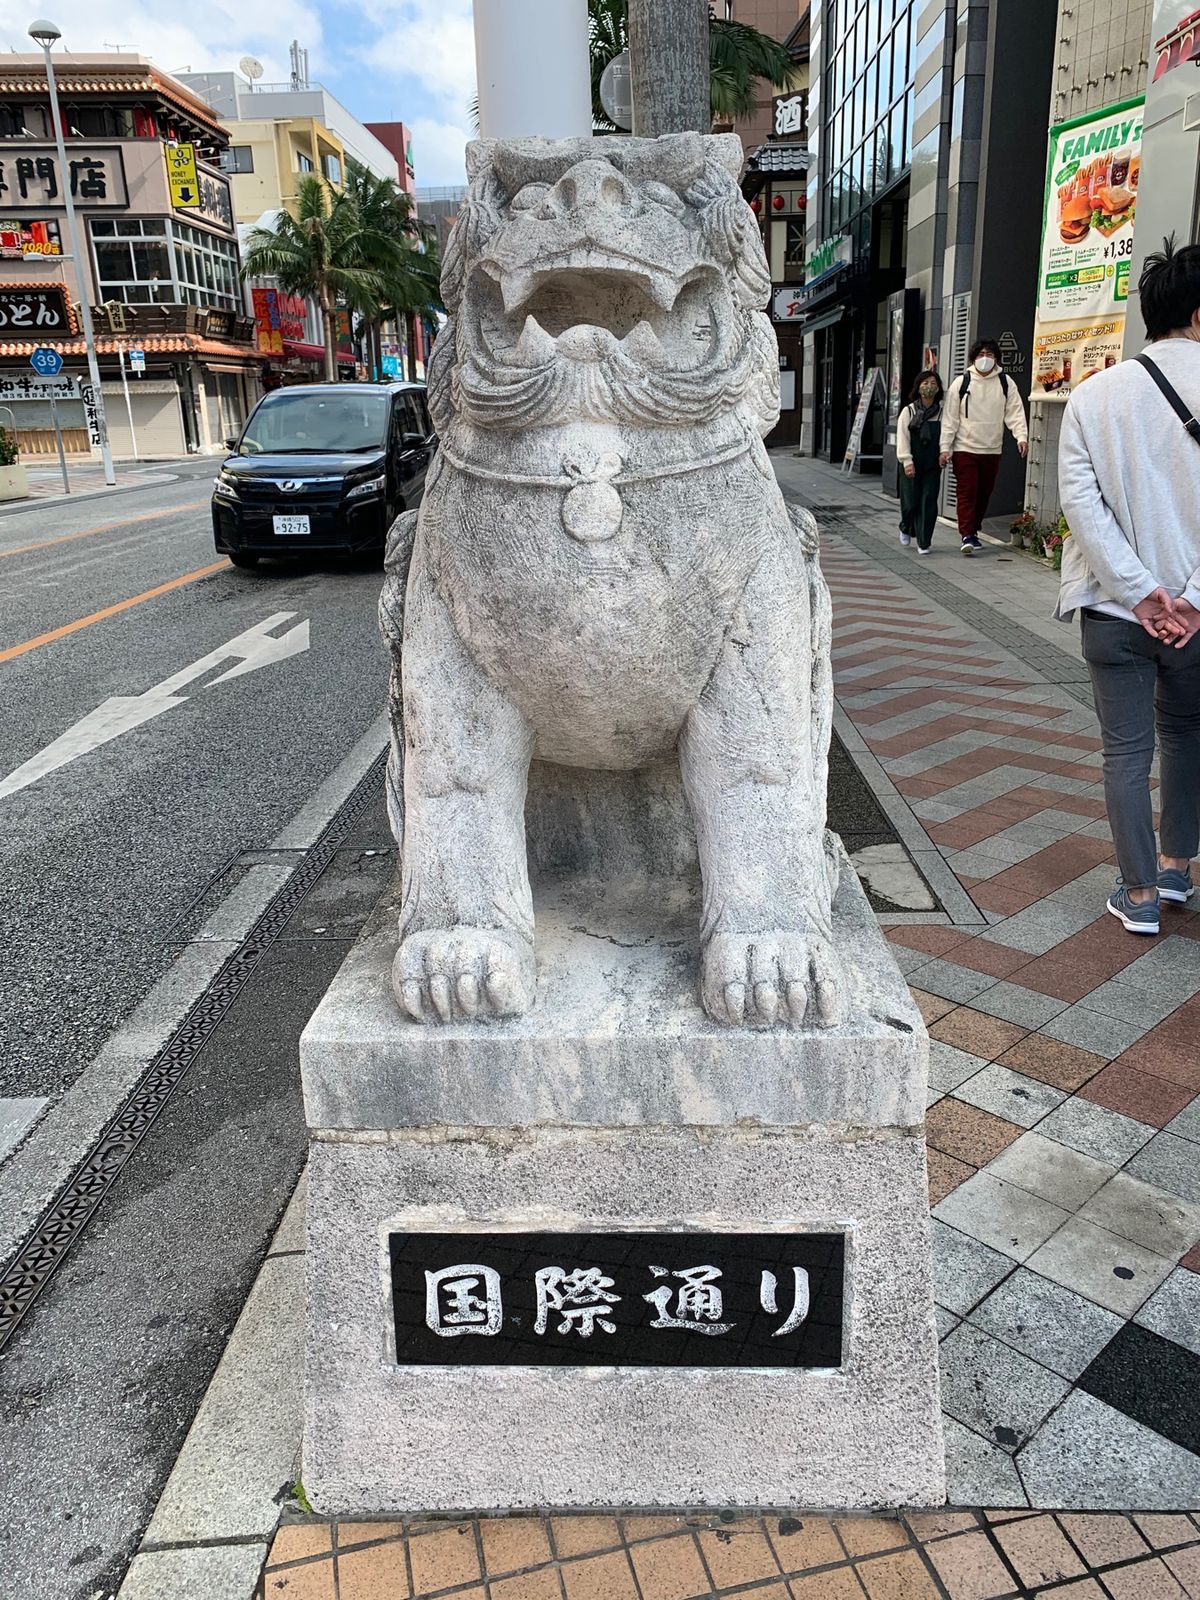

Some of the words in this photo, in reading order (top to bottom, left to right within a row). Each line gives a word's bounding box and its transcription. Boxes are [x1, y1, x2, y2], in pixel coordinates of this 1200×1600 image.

[775, 95, 808, 134] 酒
[1062, 118, 1136, 163] FAMILY
[0, 156, 106, 199] 門店
[172, 178, 195, 186] EXCHANGE
[37, 355, 57, 367] 39
[281, 522, 309, 533] 92-75
[424, 1263, 811, 1338] 国際通り
